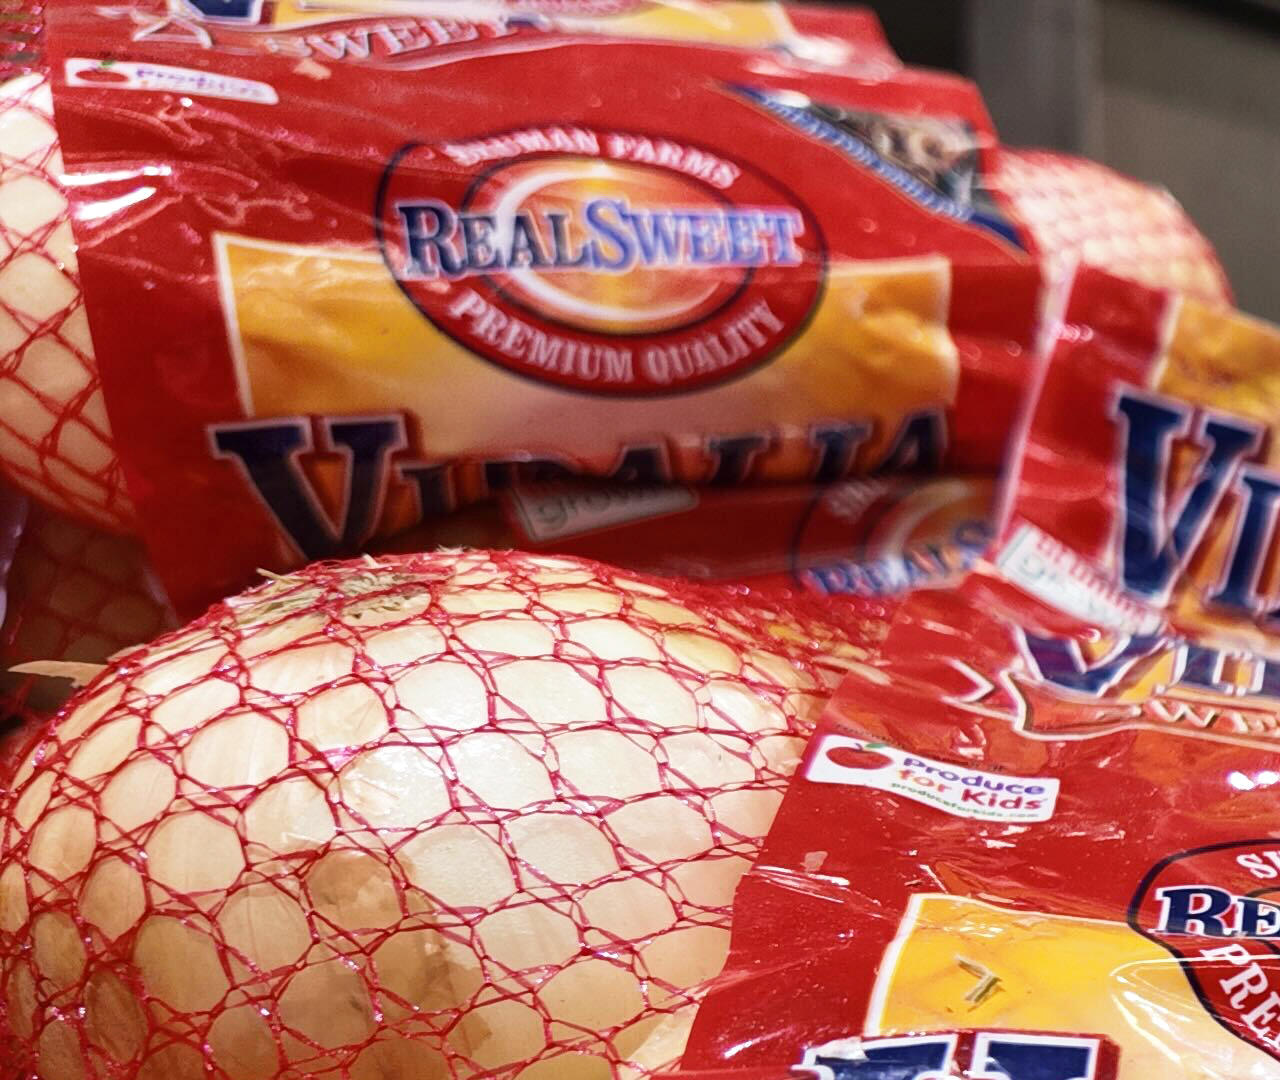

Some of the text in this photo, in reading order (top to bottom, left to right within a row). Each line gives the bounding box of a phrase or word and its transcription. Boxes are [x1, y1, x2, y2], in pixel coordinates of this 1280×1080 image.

[606, 131, 742, 190] FARMS
[449, 289, 786, 385] PREMIUM QUALITY
[897, 768, 1043, 811] for Kids
[903, 756, 1046, 795] Produce
